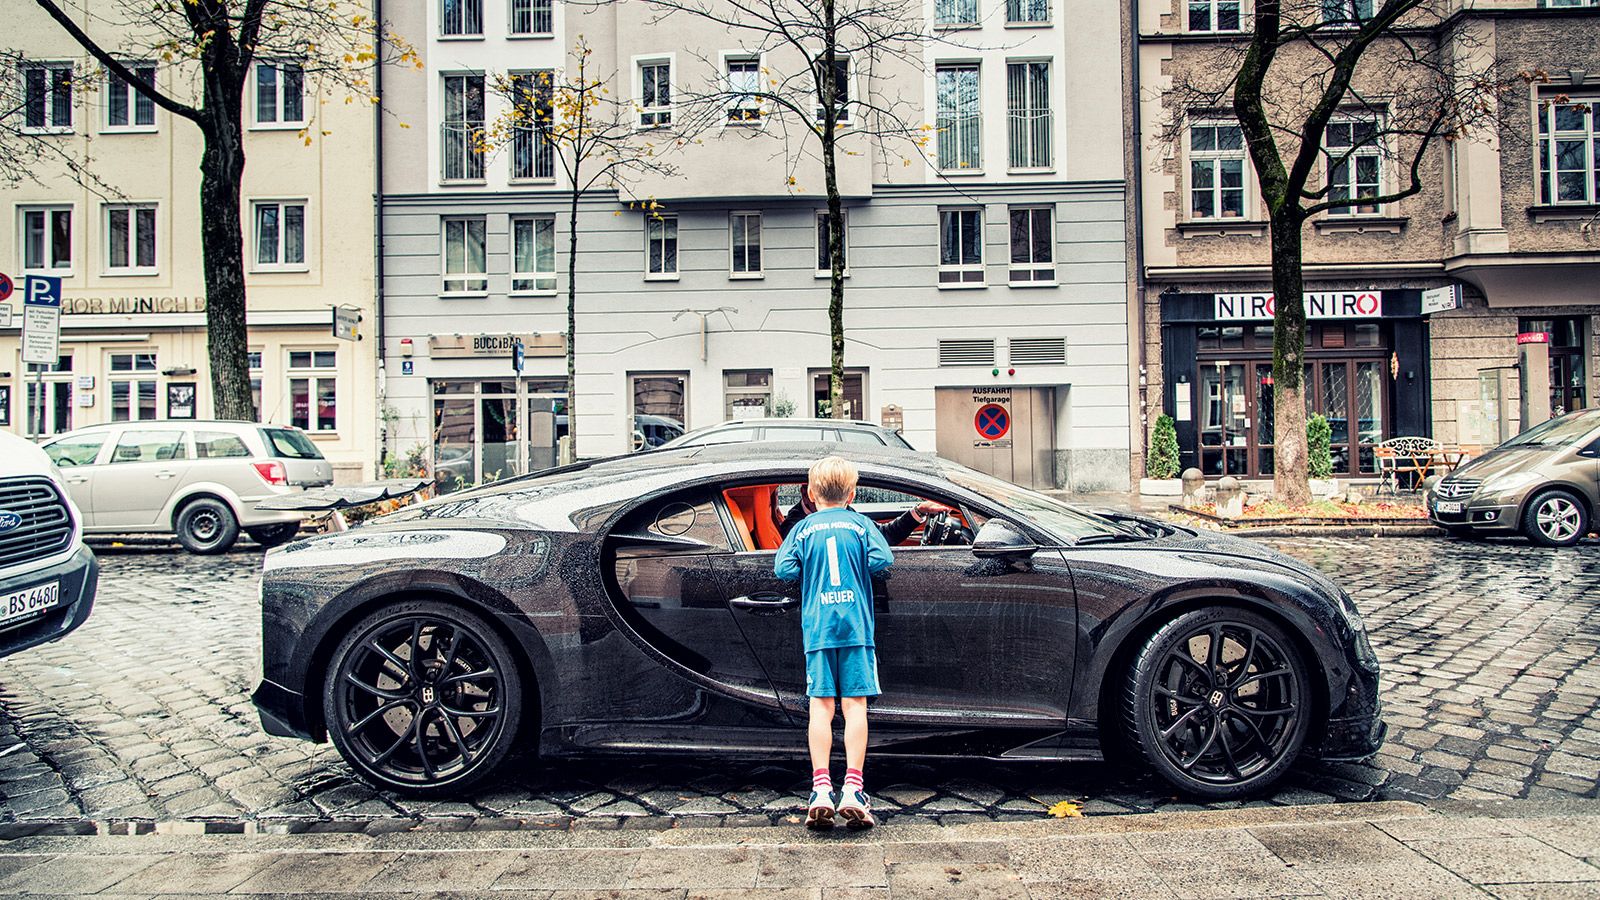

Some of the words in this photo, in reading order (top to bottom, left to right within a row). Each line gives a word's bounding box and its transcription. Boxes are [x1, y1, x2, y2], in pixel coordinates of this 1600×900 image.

[31, 279, 51, 302] P
[1309, 294, 1378, 315] NIRO
[826, 535, 841, 587] 1
[9, 593, 26, 615] BS
[29, 585, 57, 609] 6480
[820, 590, 855, 604] NEUER
